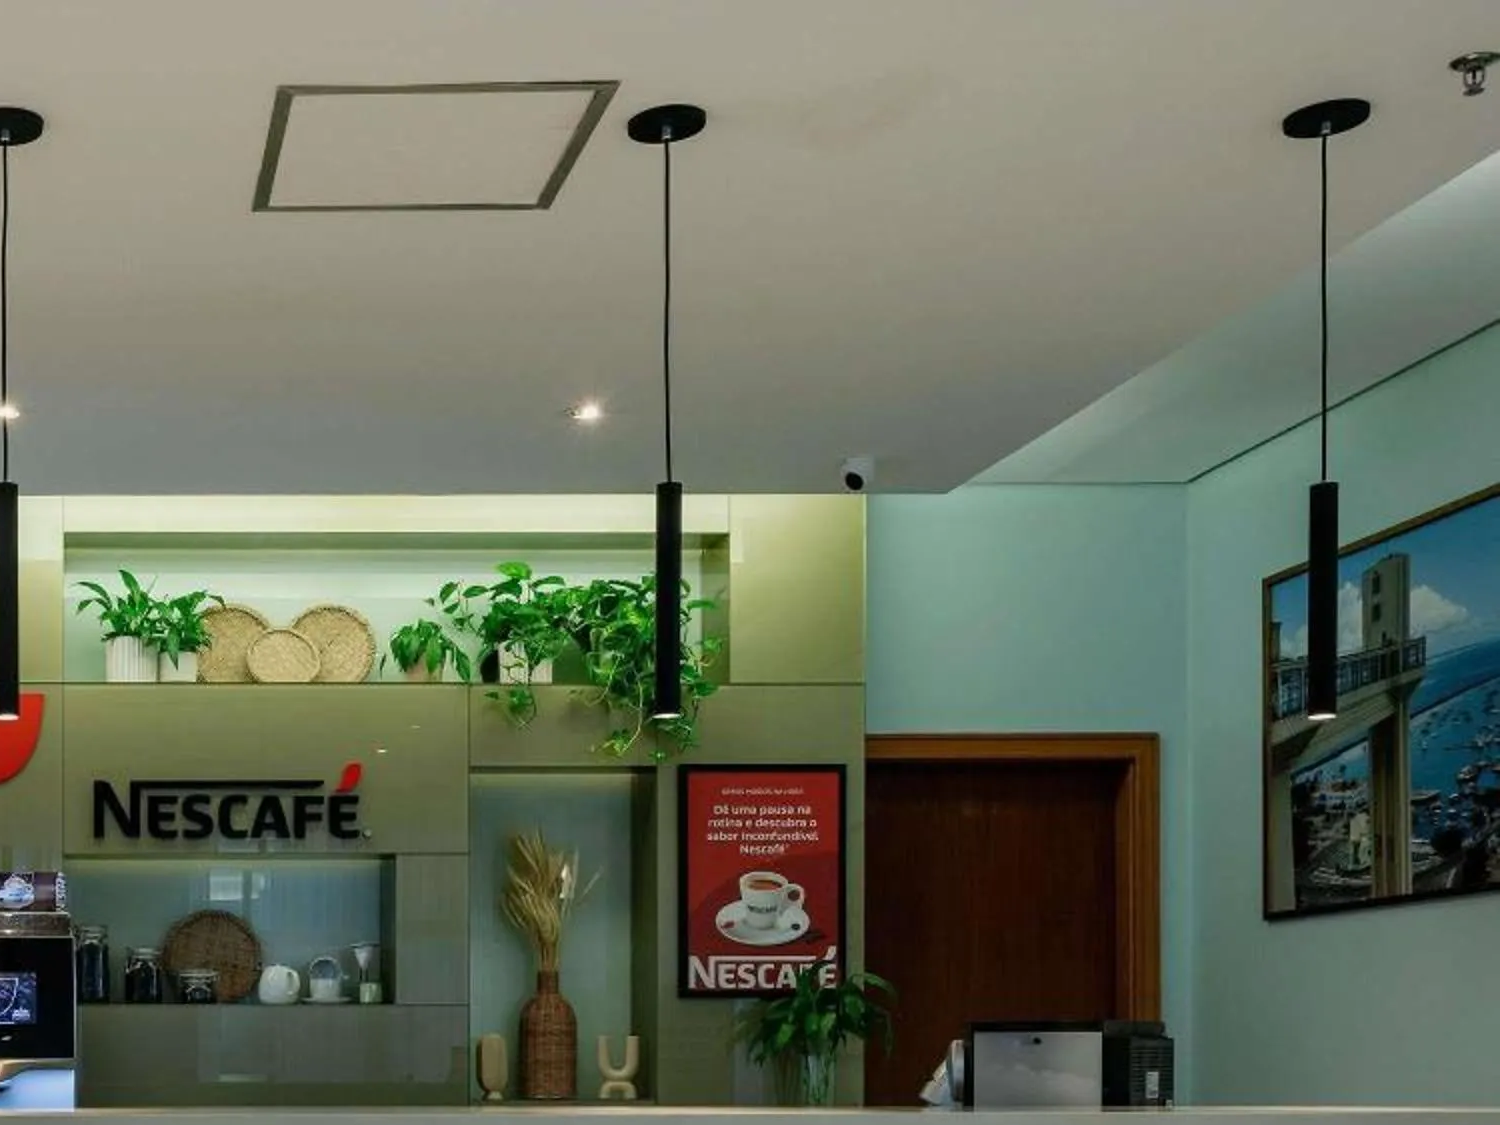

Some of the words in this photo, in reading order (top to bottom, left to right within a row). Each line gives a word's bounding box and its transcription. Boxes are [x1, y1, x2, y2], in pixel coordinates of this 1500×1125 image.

[92, 762, 362, 841] NESCAFÉ
[731, 806, 757, 815] uma
[759, 806, 795, 817] pausa
[755, 817, 807, 828] descubra
[809, 819, 817, 827] o
[707, 831, 738, 841] sabor
